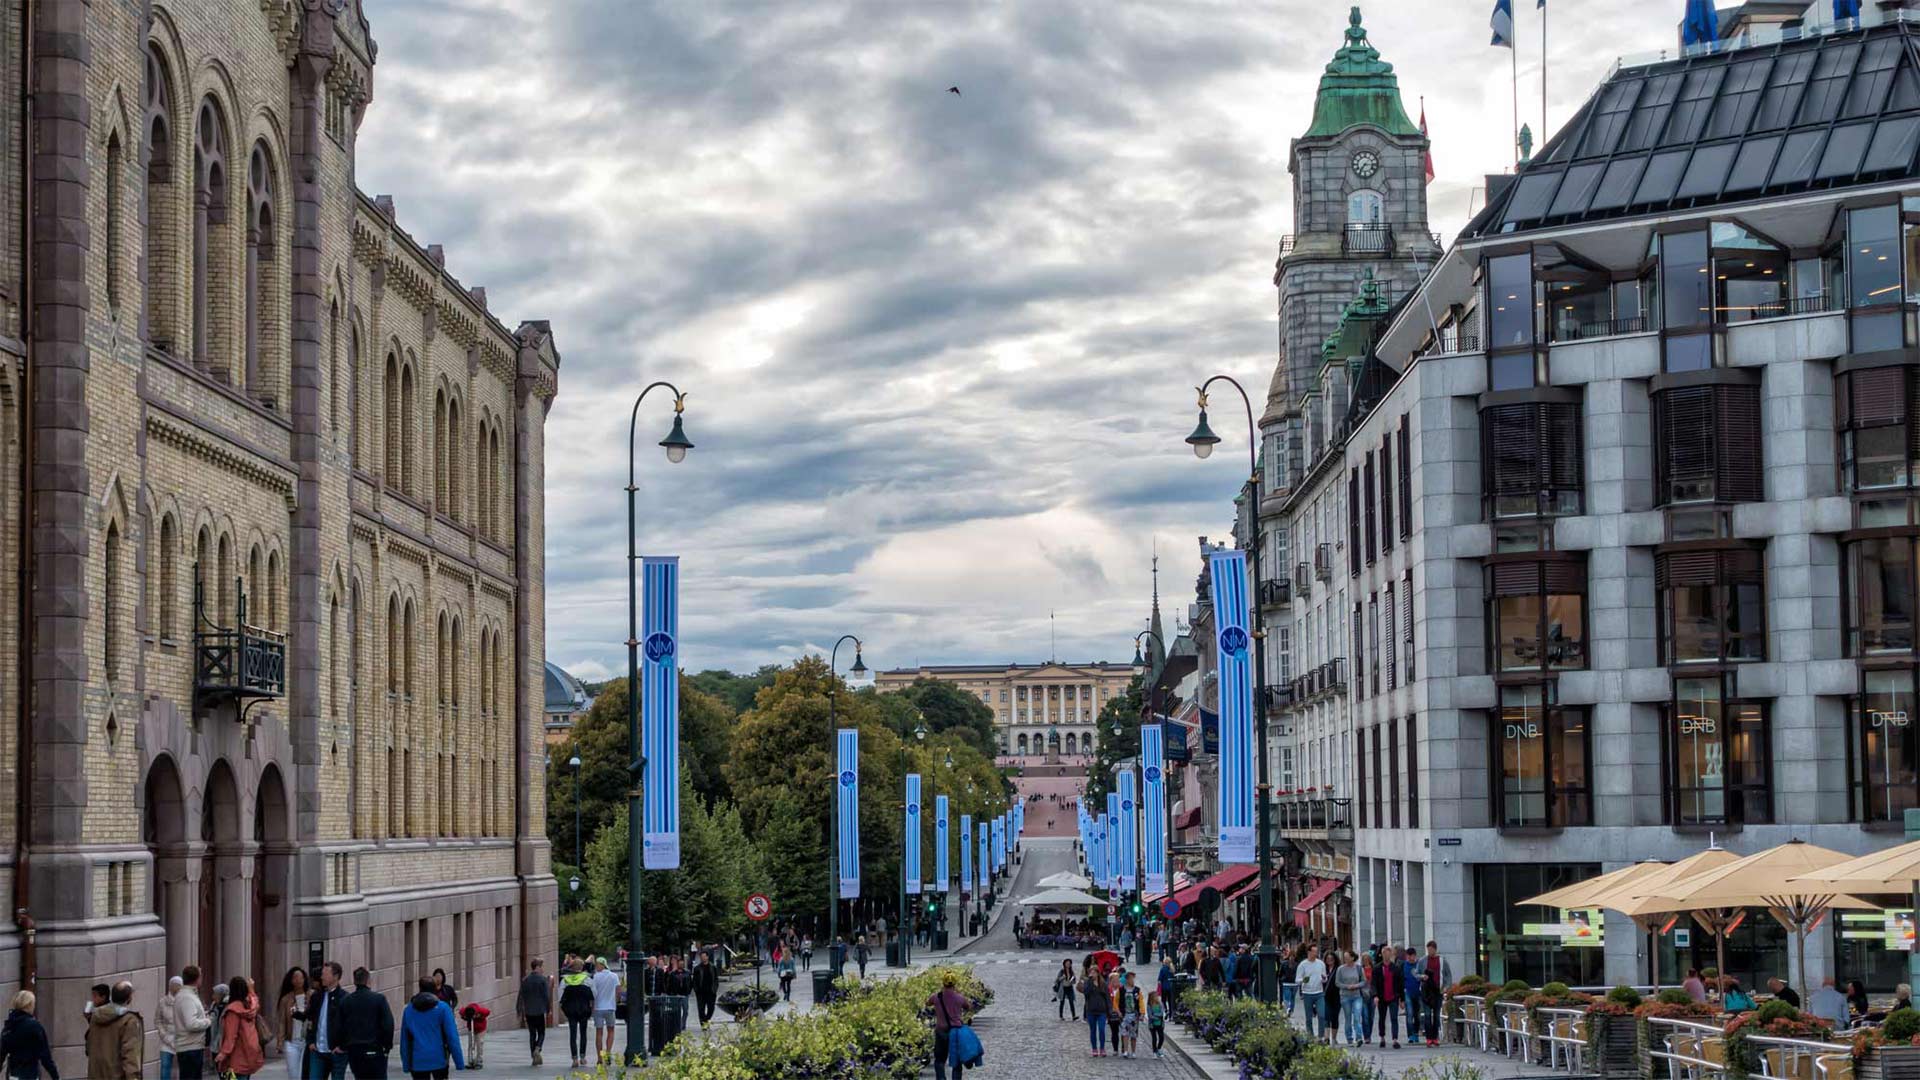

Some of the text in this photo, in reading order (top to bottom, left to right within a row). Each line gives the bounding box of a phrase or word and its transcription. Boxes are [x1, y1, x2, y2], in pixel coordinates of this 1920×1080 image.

[648, 633, 672, 658] NJM
[1223, 628, 1246, 652] NJM
[1682, 718, 1716, 734] DNB
[1872, 711, 1909, 727] DNB
[1506, 723, 1538, 739] DNB
